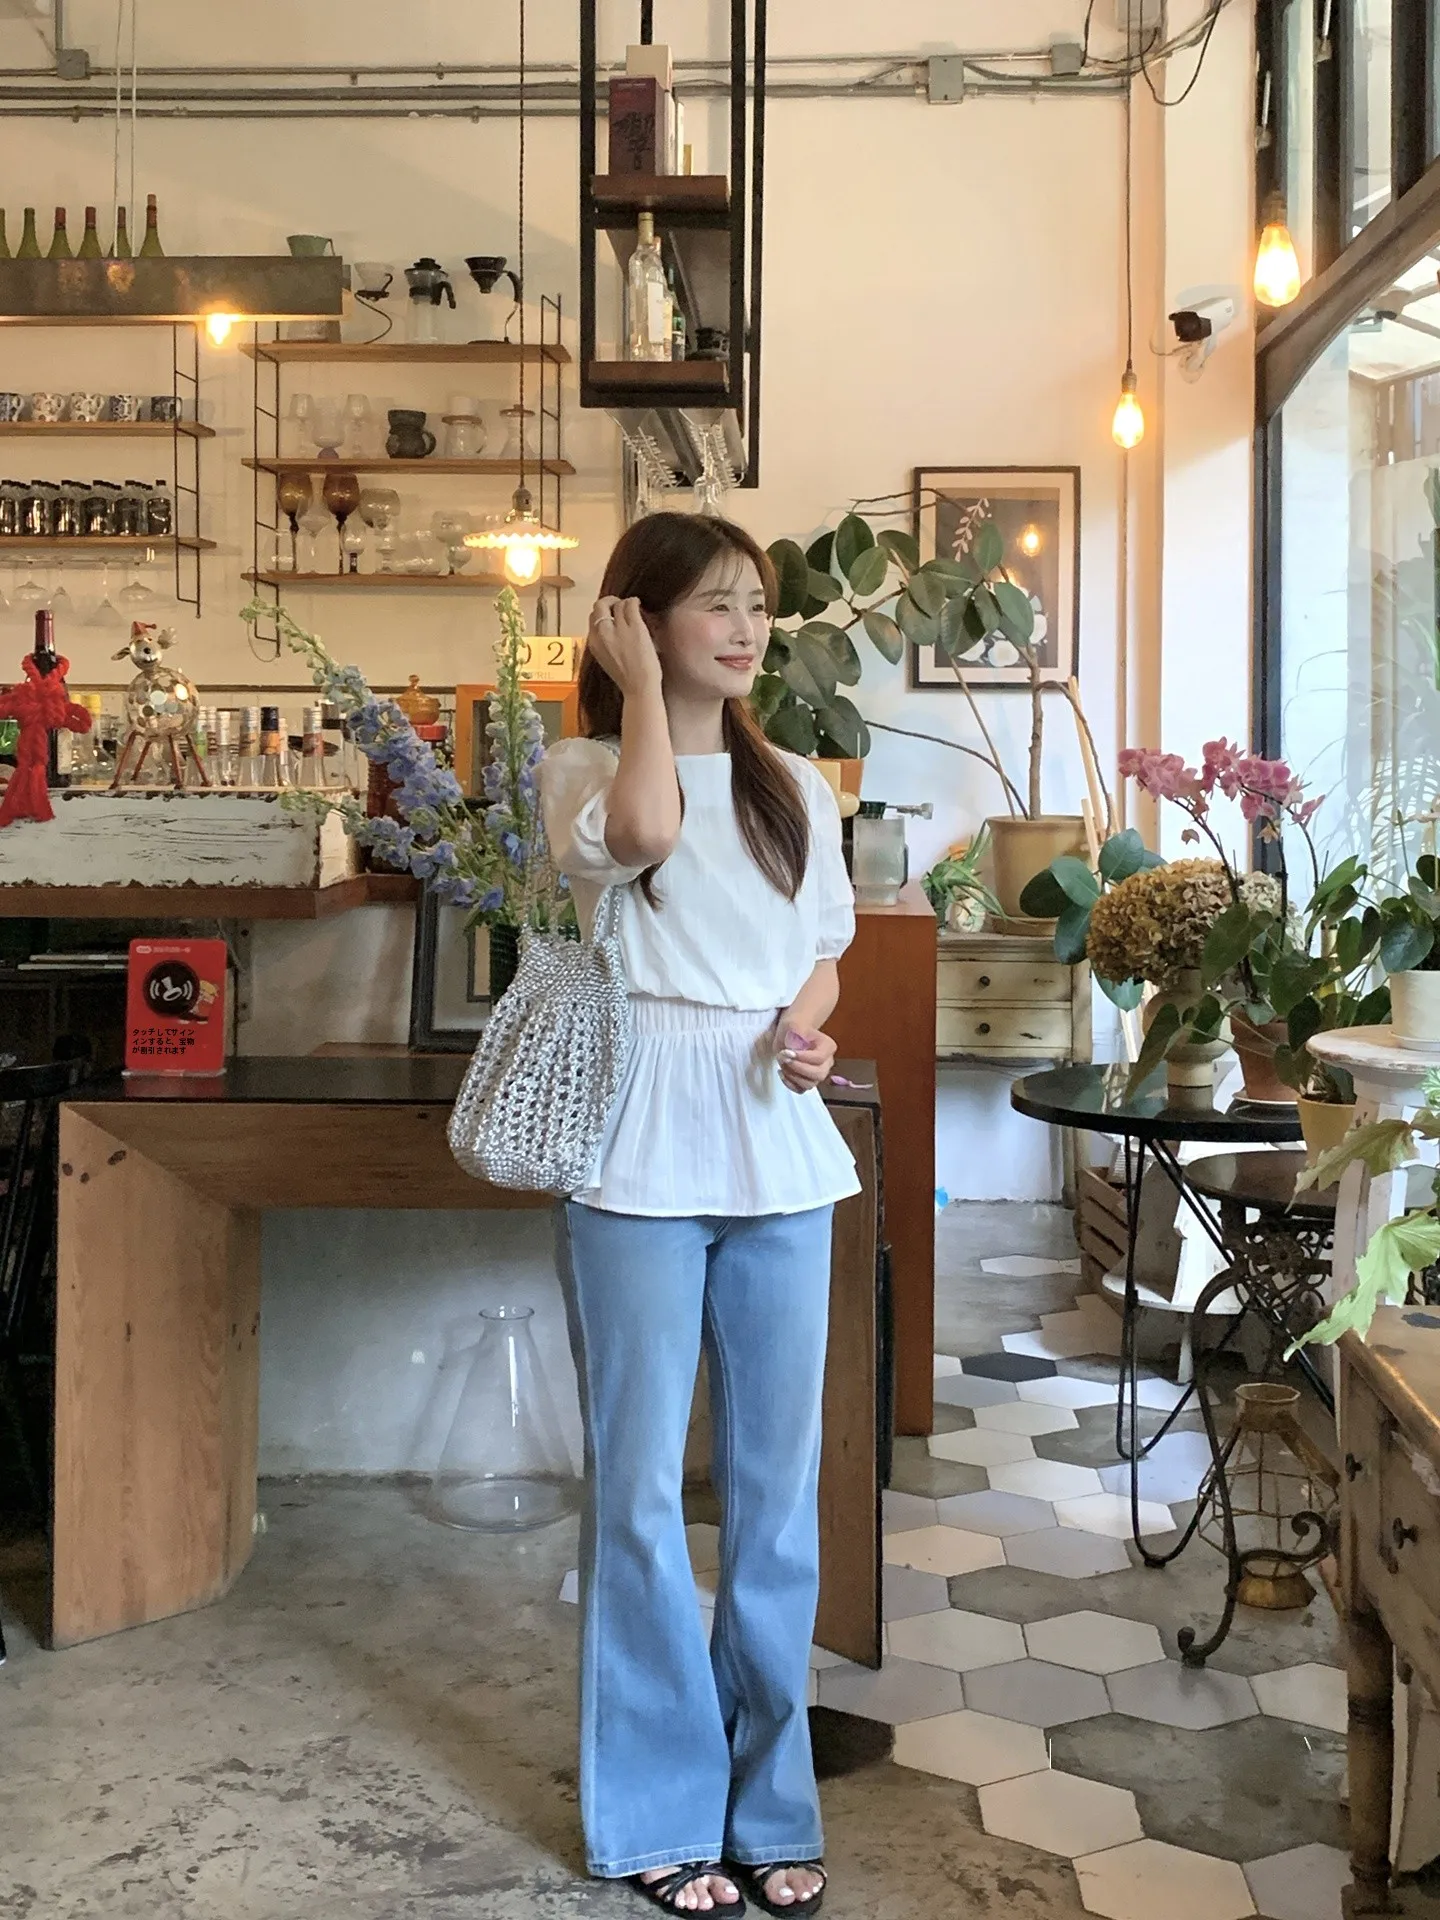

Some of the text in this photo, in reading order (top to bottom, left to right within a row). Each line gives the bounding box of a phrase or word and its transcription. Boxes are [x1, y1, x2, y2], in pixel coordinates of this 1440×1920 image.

[132, 1027, 195, 1037] タッチしてサイン
[132, 1037, 195, 1046] インすると、宝物
[131, 1046, 187, 1055] が割引されます
